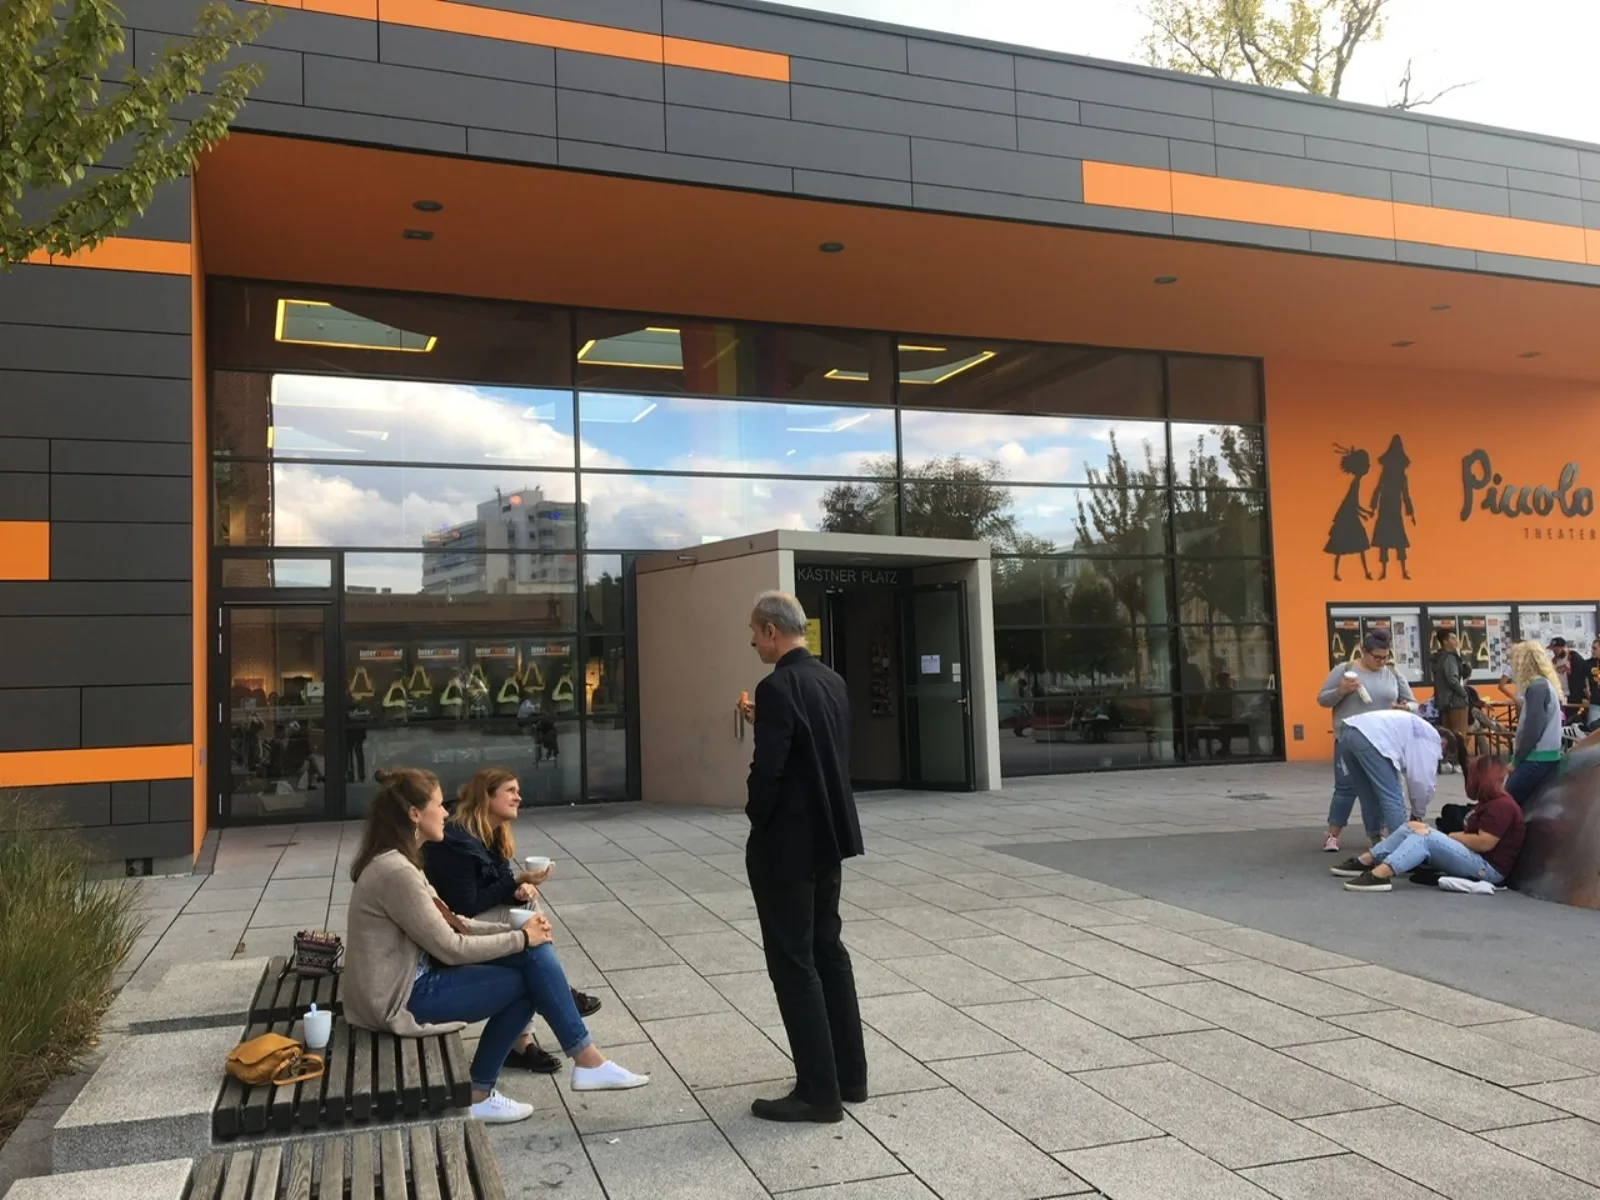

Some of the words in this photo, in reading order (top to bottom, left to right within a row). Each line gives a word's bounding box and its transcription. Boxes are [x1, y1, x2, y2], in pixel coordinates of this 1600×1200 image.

[1460, 448, 1594, 522] Piccolo
[1523, 527, 1597, 541] THEATER
[862, 571, 898, 584] PLATZ
